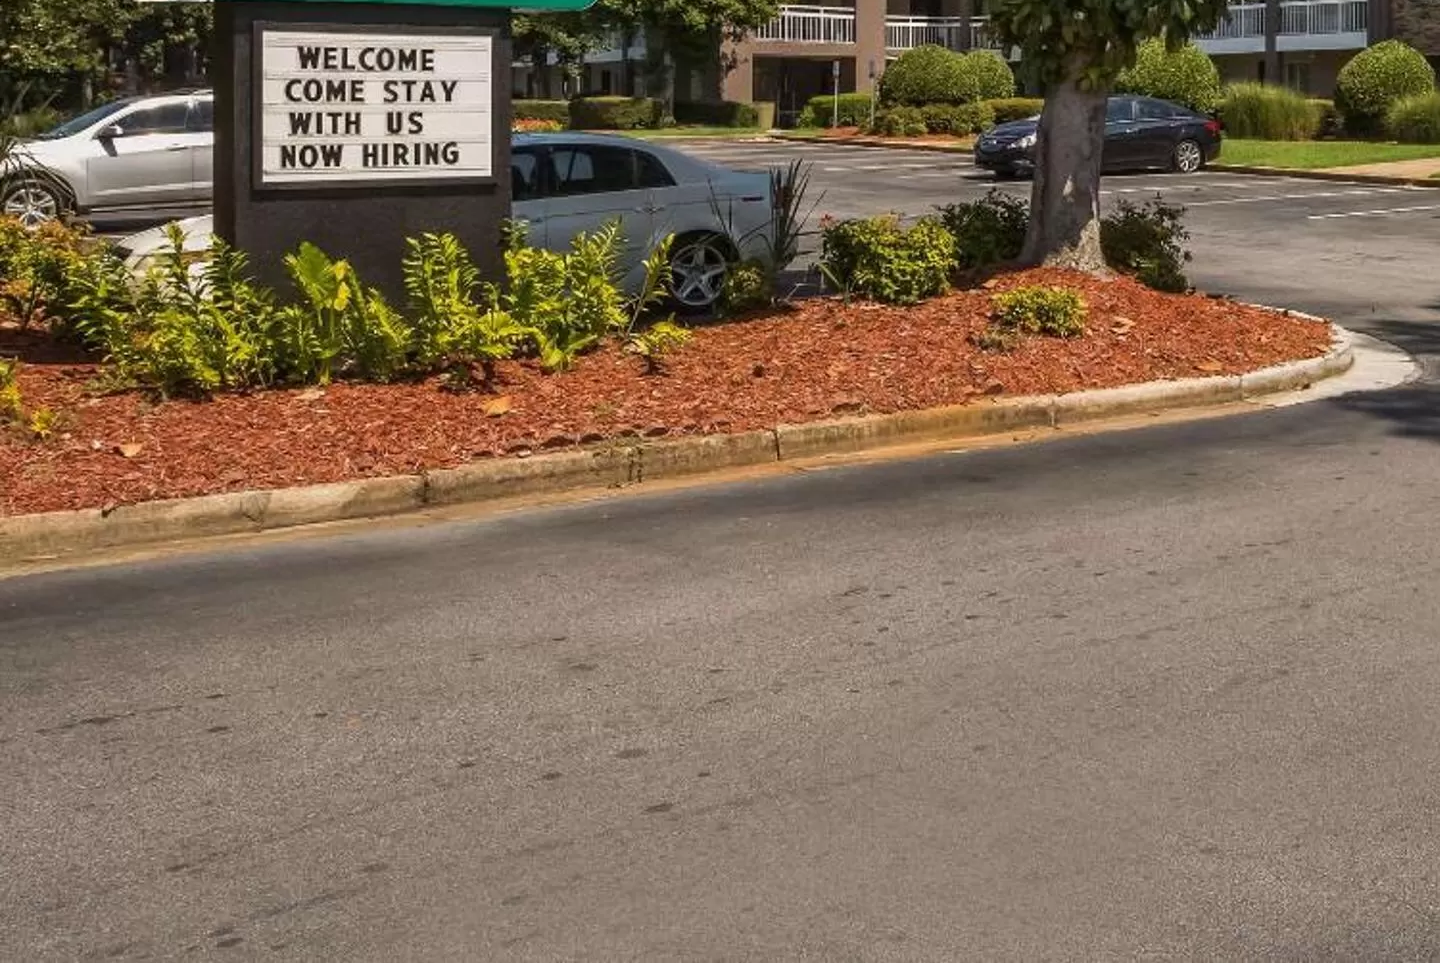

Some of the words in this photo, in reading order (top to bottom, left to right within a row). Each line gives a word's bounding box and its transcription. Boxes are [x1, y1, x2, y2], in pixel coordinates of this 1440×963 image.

[298, 46, 434, 71] WELCOME
[285, 79, 364, 102] COME
[383, 80, 457, 103] STAY
[289, 112, 361, 135] WITH
[387, 111, 423, 134] US
[281, 145, 343, 168] NOW
[363, 142, 459, 167] HIRING
